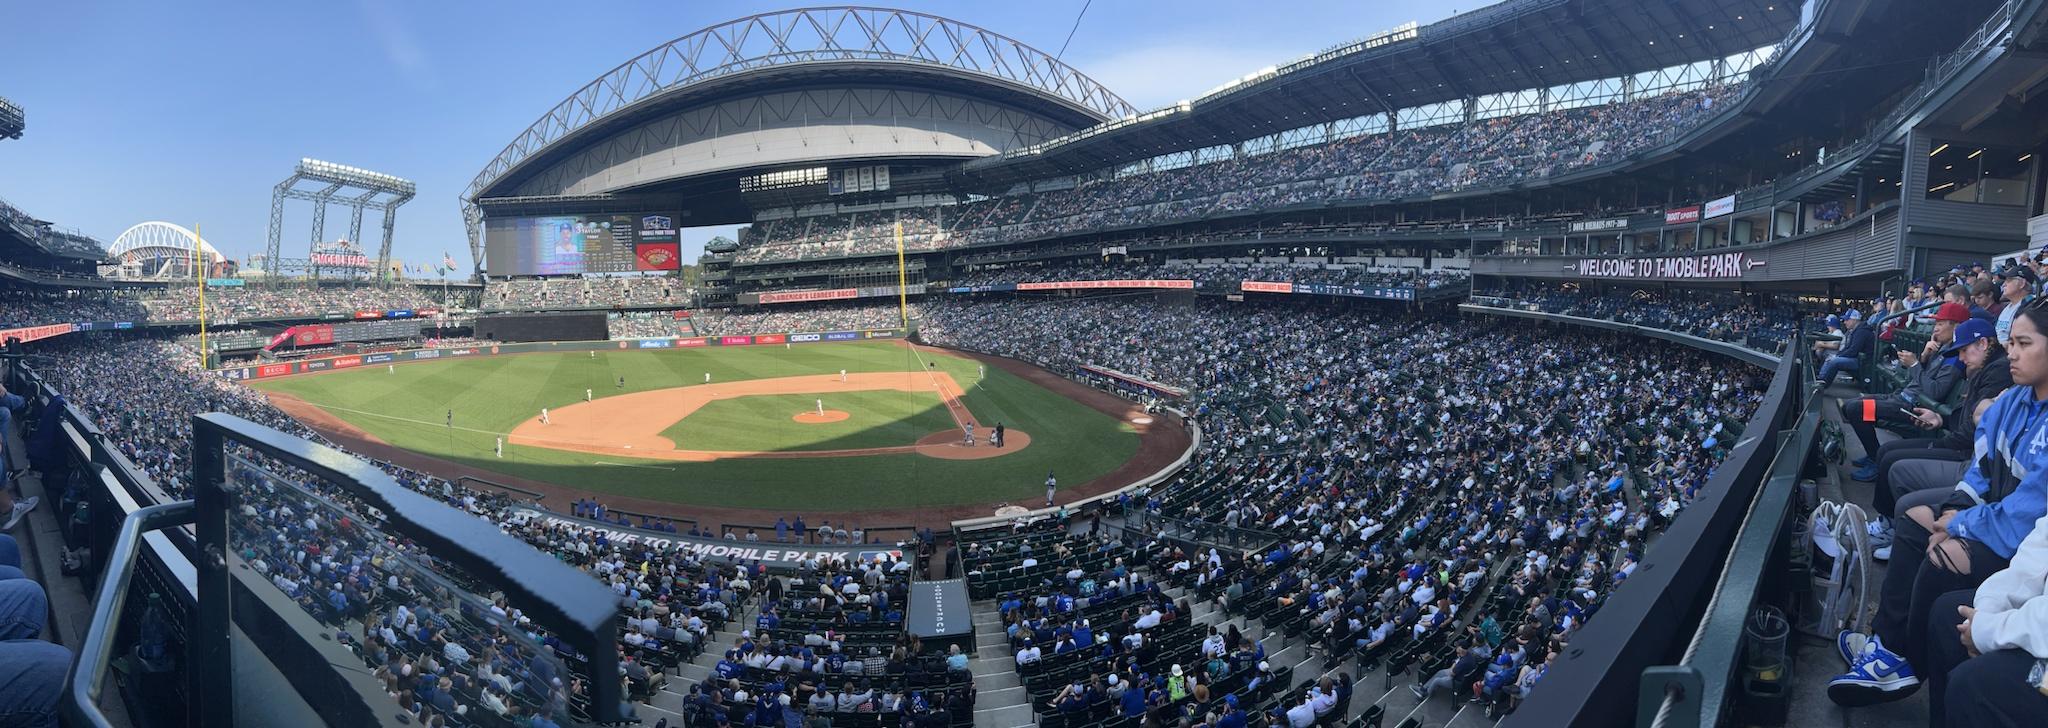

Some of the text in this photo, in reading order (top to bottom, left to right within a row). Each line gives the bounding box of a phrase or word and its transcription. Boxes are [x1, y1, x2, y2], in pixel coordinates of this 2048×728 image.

[1666, 210, 1698, 223] ROOT SPORTS
[1580, 252, 1743, 278] WELCOME TO T-MOBILE PARK
[776, 292, 808, 300] AMERICA'S
[810, 291, 835, 299] LEANEST
[791, 333, 820, 342] GEICO
[643, 536, 672, 549] TO
[676, 541, 780, 561] T-MOBILE
[783, 550, 849, 563] PARK
[1213, 643, 1225, 655] 22
